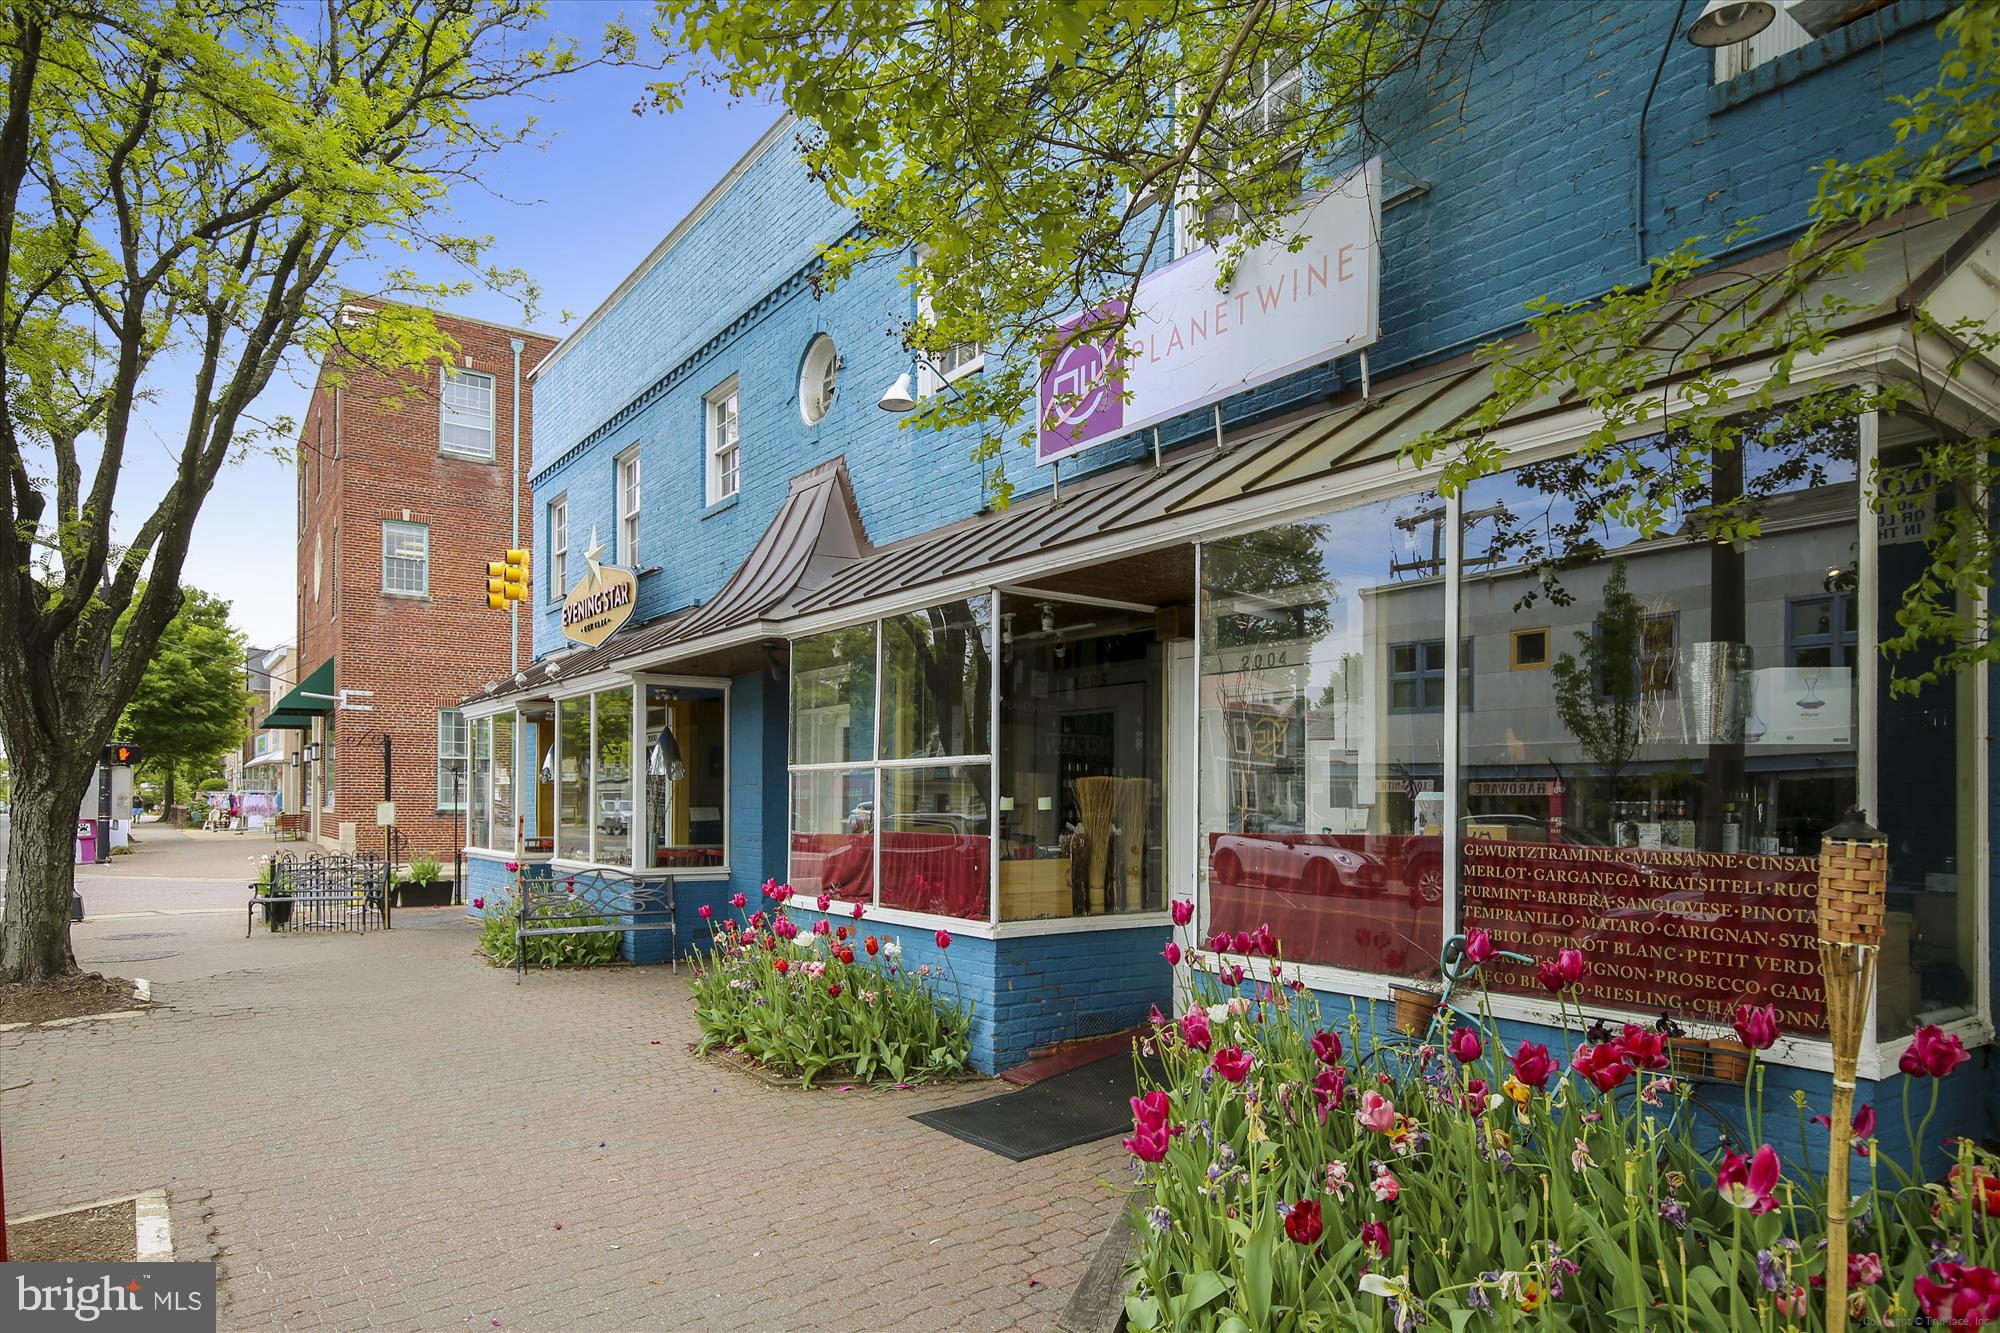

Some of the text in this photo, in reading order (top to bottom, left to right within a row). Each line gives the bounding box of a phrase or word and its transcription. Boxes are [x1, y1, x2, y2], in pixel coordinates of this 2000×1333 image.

[1131, 243, 1354, 371] PLANETWINE
[563, 581, 630, 627] EVENING STAR
[1241, 651, 1287, 671] 2004
[1464, 844, 1625, 863] GEWURTZTRAMINER
[1633, 852, 1737, 868] MARSANNE
[1463, 864, 1528, 880] MERLOT
[1534, 869, 1641, 887] GARGANEGA
[1650, 875, 1764, 895] RKATSITELI
[1464, 885, 1532, 901] FURMINT
[1537, 890, 1610, 908] BARBERA
[1617, 896, 1733, 917] SANGIOVESE
[1463, 905, 1574, 927] TEMPRANILLO
[1582, 916, 1655, 934] MATARO
[1663, 923, 1768, 945] CARIGNAN
[1463, 926, 1544, 946] BIOLO
[1553, 935, 1609, 952] PINOT
[1614, 942, 1677, 961] BLANC
[1686, 949, 1749, 968] PETIT
[1655, 969, 1760, 994] PROSECCO
[1770, 983, 1827, 1003] GAM
[1594, 984, 1682, 1009] RIESLING
[1693, 999, 1830, 1029] CHAONNA
